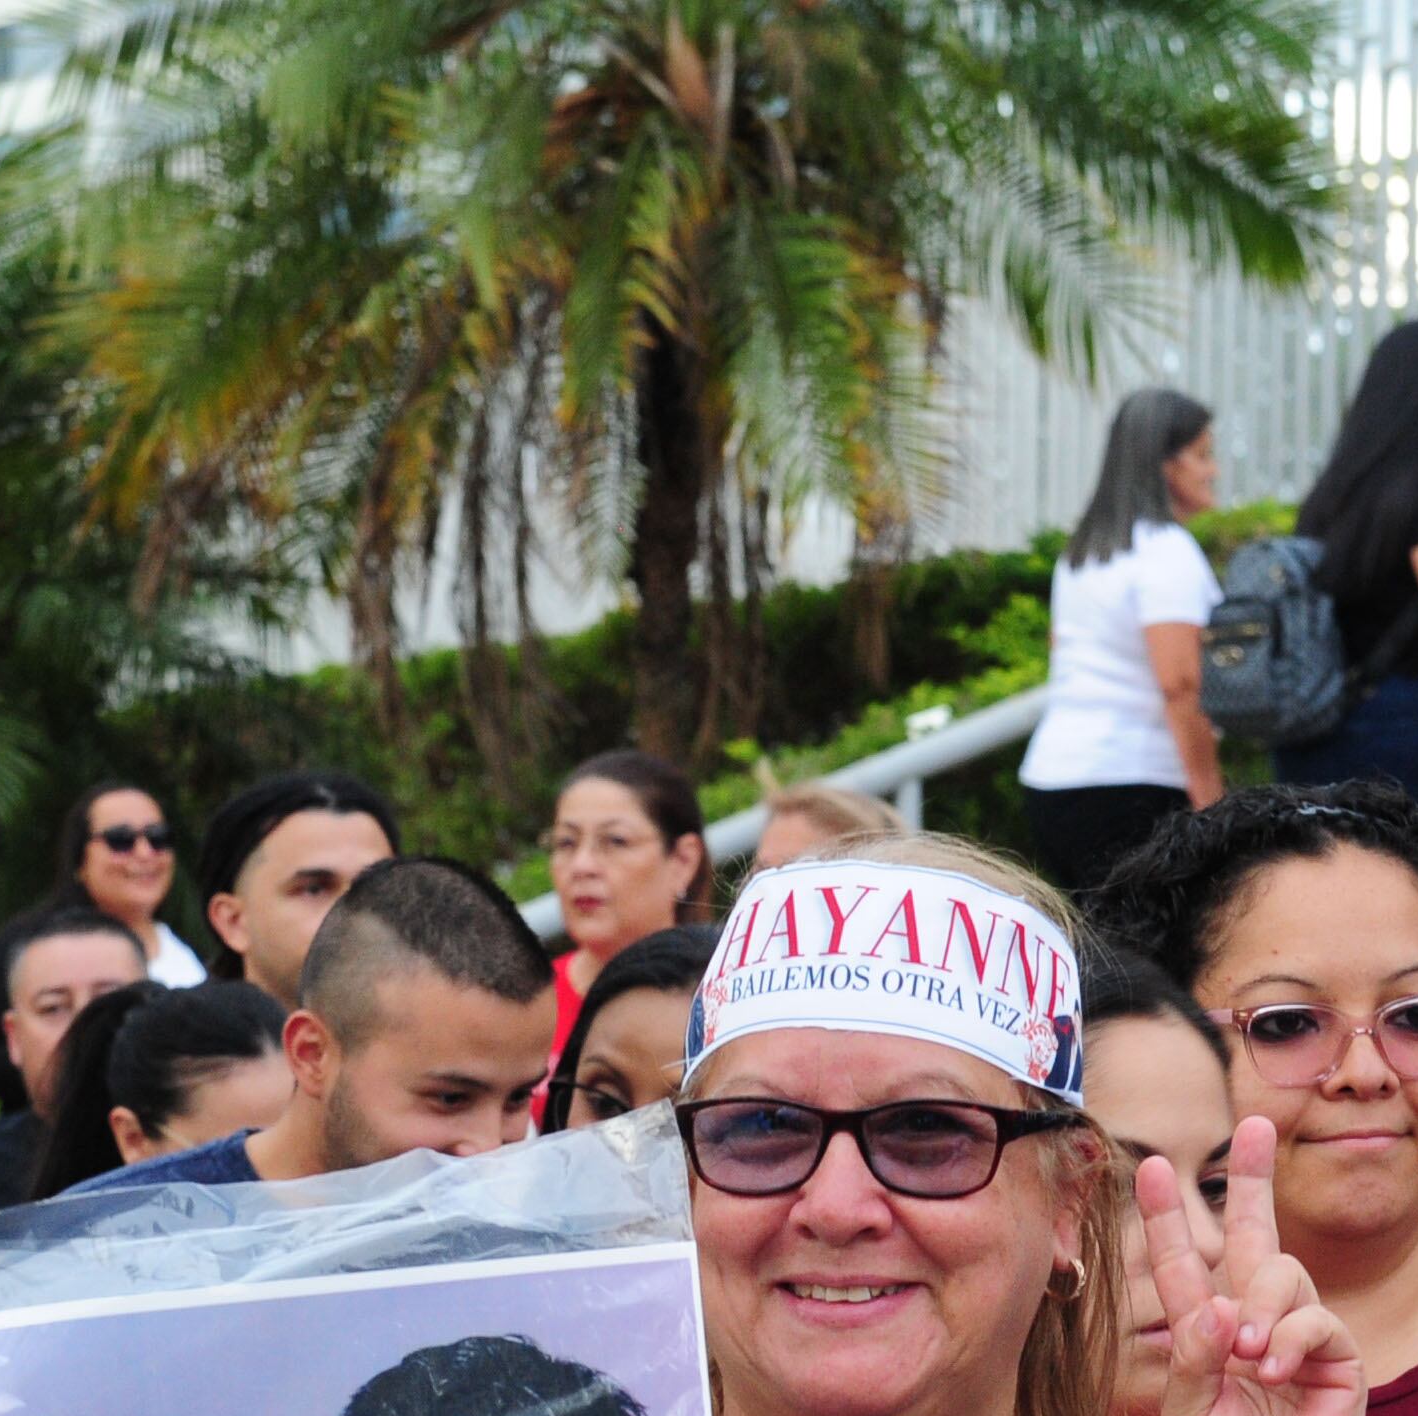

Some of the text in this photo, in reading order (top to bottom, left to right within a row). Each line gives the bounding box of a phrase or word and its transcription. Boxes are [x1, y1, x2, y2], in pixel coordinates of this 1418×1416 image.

[709, 885, 1071, 1033] HAYANNE
[730, 963, 1021, 1036] BAILEMOS OTRA VEZ
